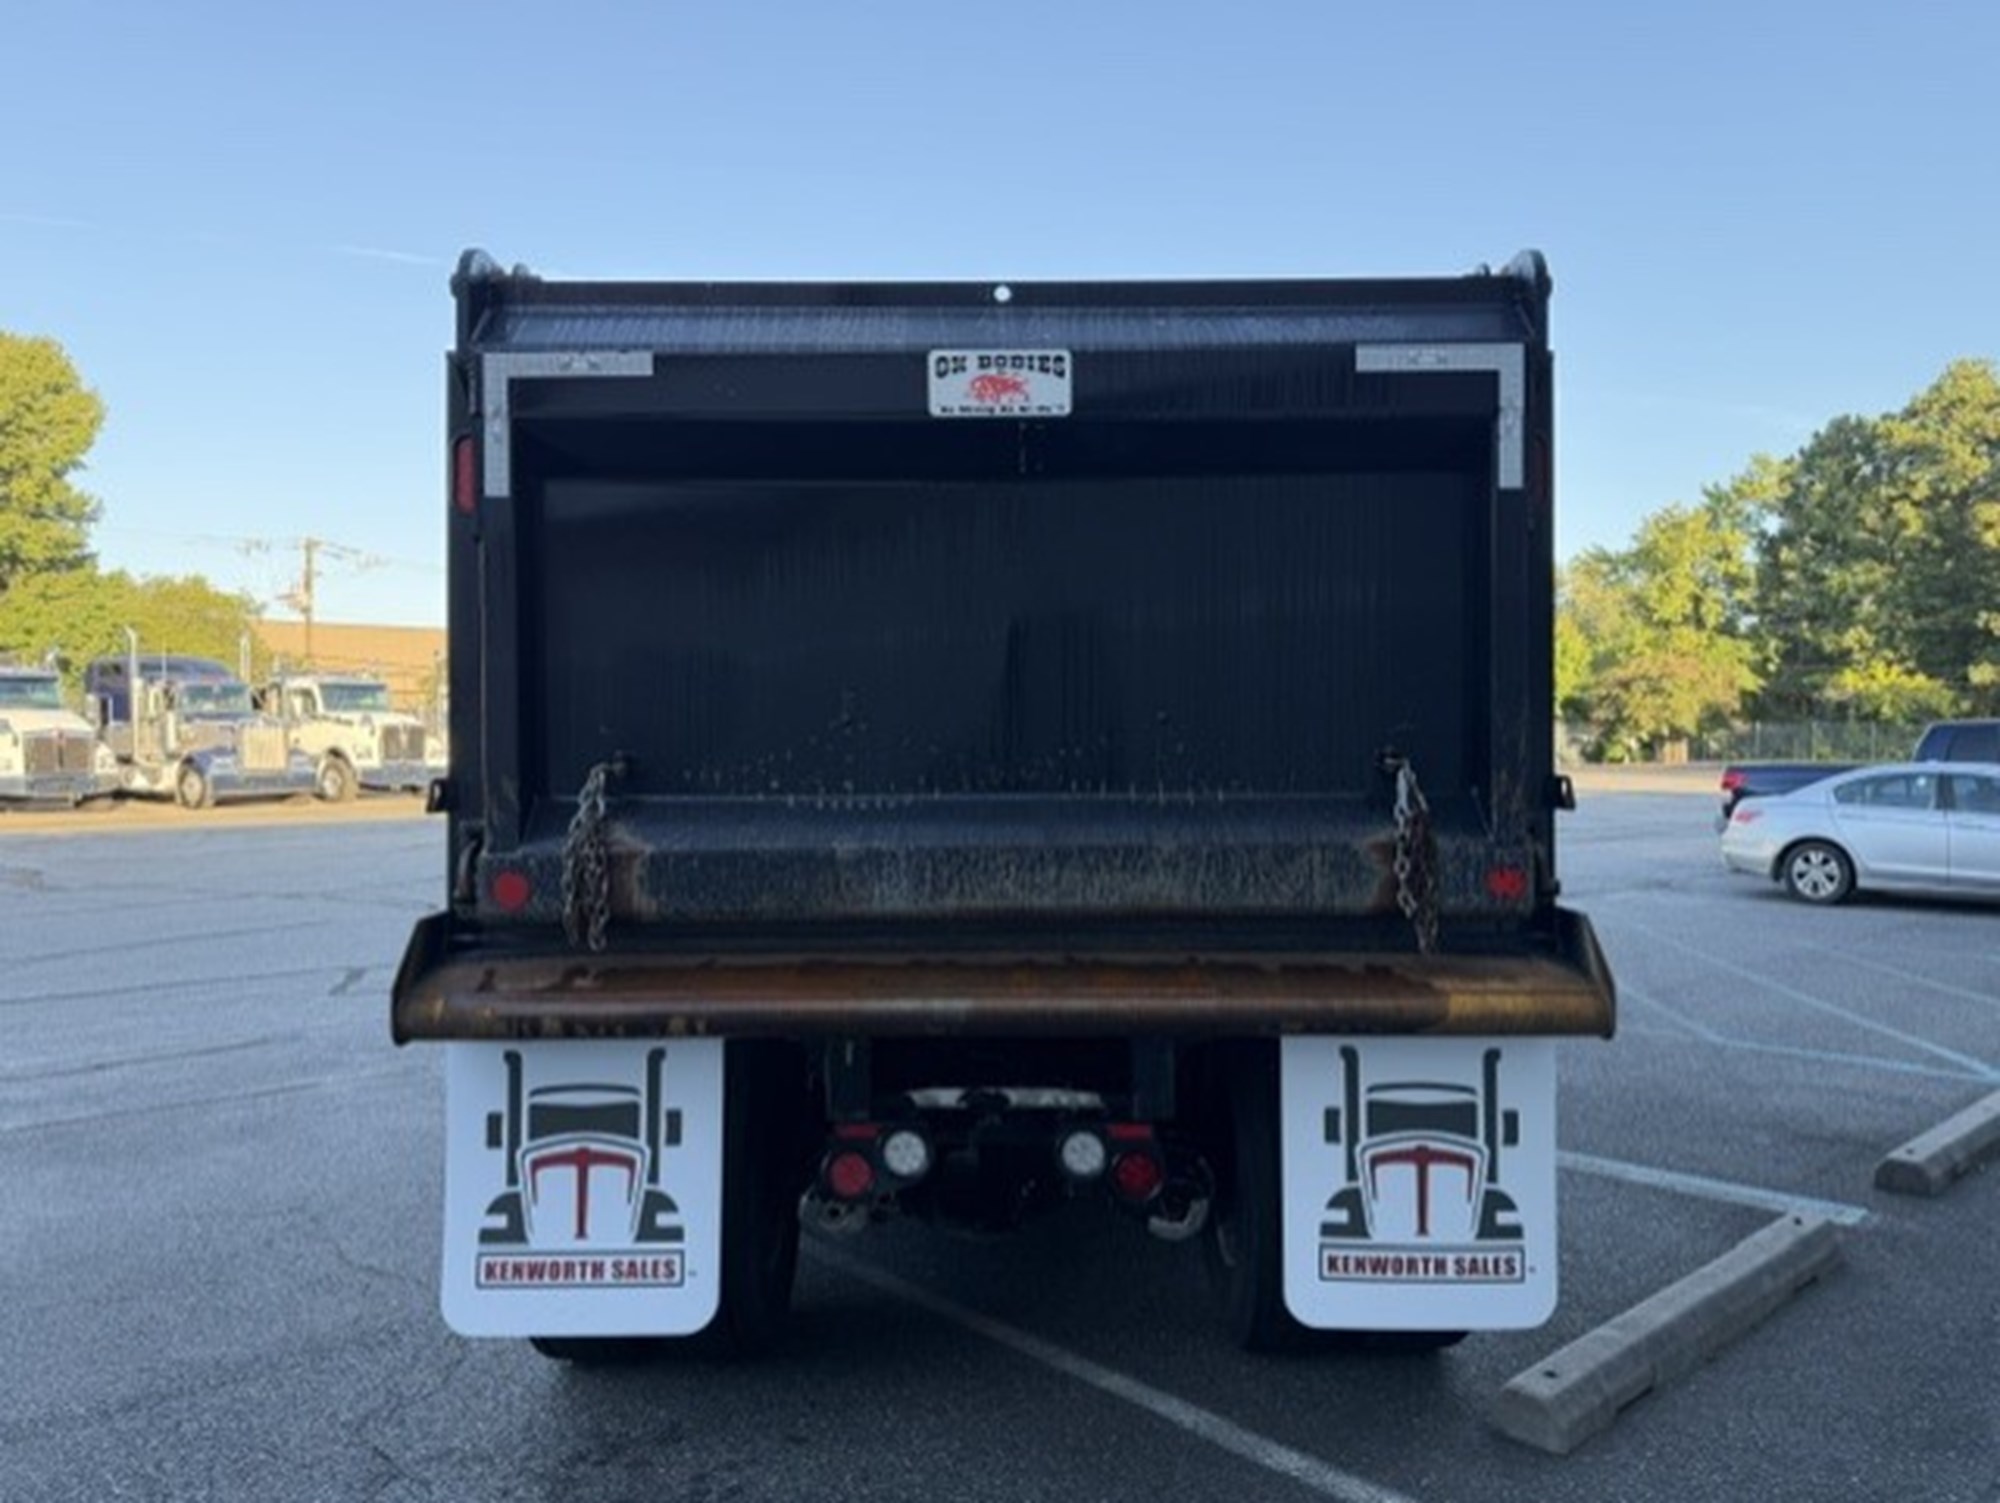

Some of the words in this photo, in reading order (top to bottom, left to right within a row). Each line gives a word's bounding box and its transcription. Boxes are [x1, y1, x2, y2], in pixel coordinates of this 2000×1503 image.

[978, 355, 1066, 378] BODIES
[485, 1259, 605, 1281] KENWORTH
[611, 1258, 676, 1280] SALES
[1327, 1255, 1447, 1275] KENWORTH
[1454, 1255, 1516, 1276] SALES
